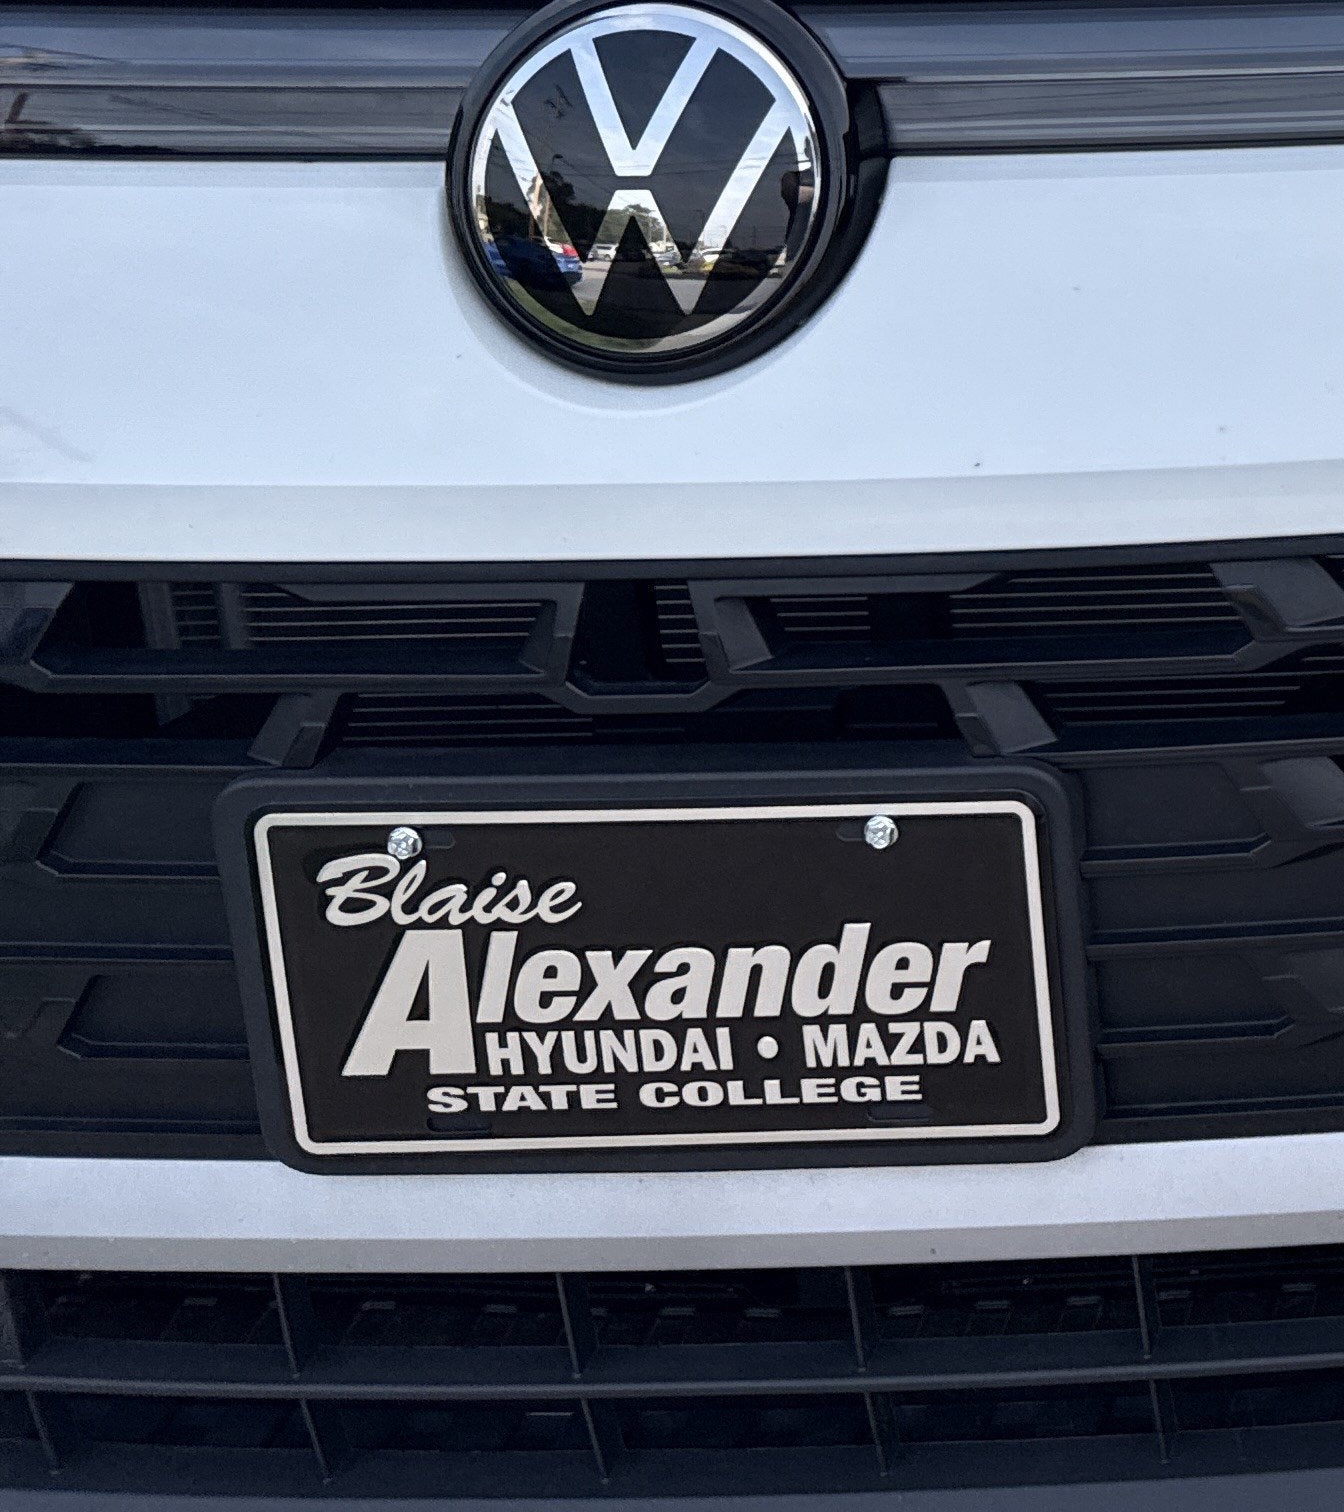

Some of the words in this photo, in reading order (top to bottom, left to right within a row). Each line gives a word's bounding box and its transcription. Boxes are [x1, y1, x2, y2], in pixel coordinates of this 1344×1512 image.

[316, 852, 583, 927] Blaise
[341, 922, 993, 1077] Alexander
[485, 1025, 735, 1076] HYUNDAI
[802, 1019, 1001, 1068] MAZDA
[426, 1083, 618, 1113] STATE
[639, 1074, 923, 1108] COLLEGE
